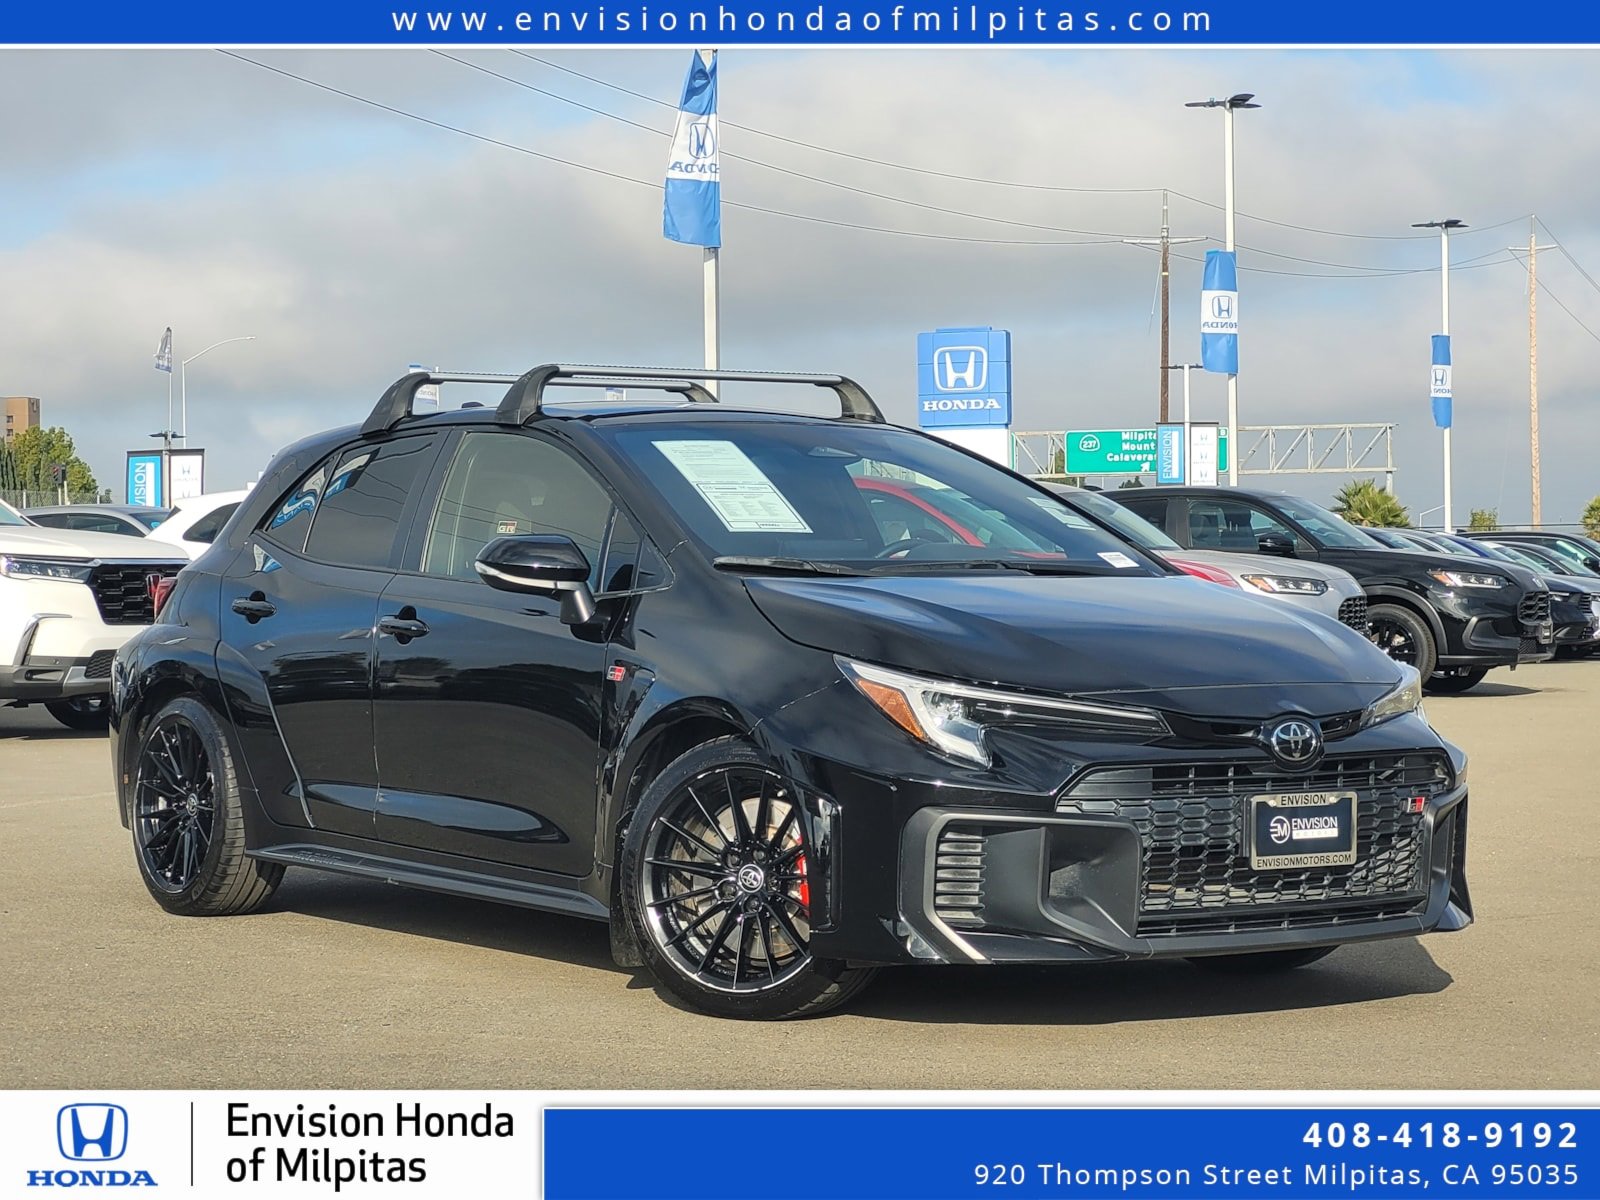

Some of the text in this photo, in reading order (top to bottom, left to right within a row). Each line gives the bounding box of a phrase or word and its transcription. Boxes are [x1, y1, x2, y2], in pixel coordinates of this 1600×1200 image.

[923, 398, 1002, 412] HONDA
[1082, 440, 1096, 449] 237
[1163, 430, 1172, 479] ENVISION
[1280, 794, 1327, 806] ENVISION
[1291, 816, 1338, 830] ENVISION
[1257, 854, 1352, 868] ENVISIONMOTORS.COM
